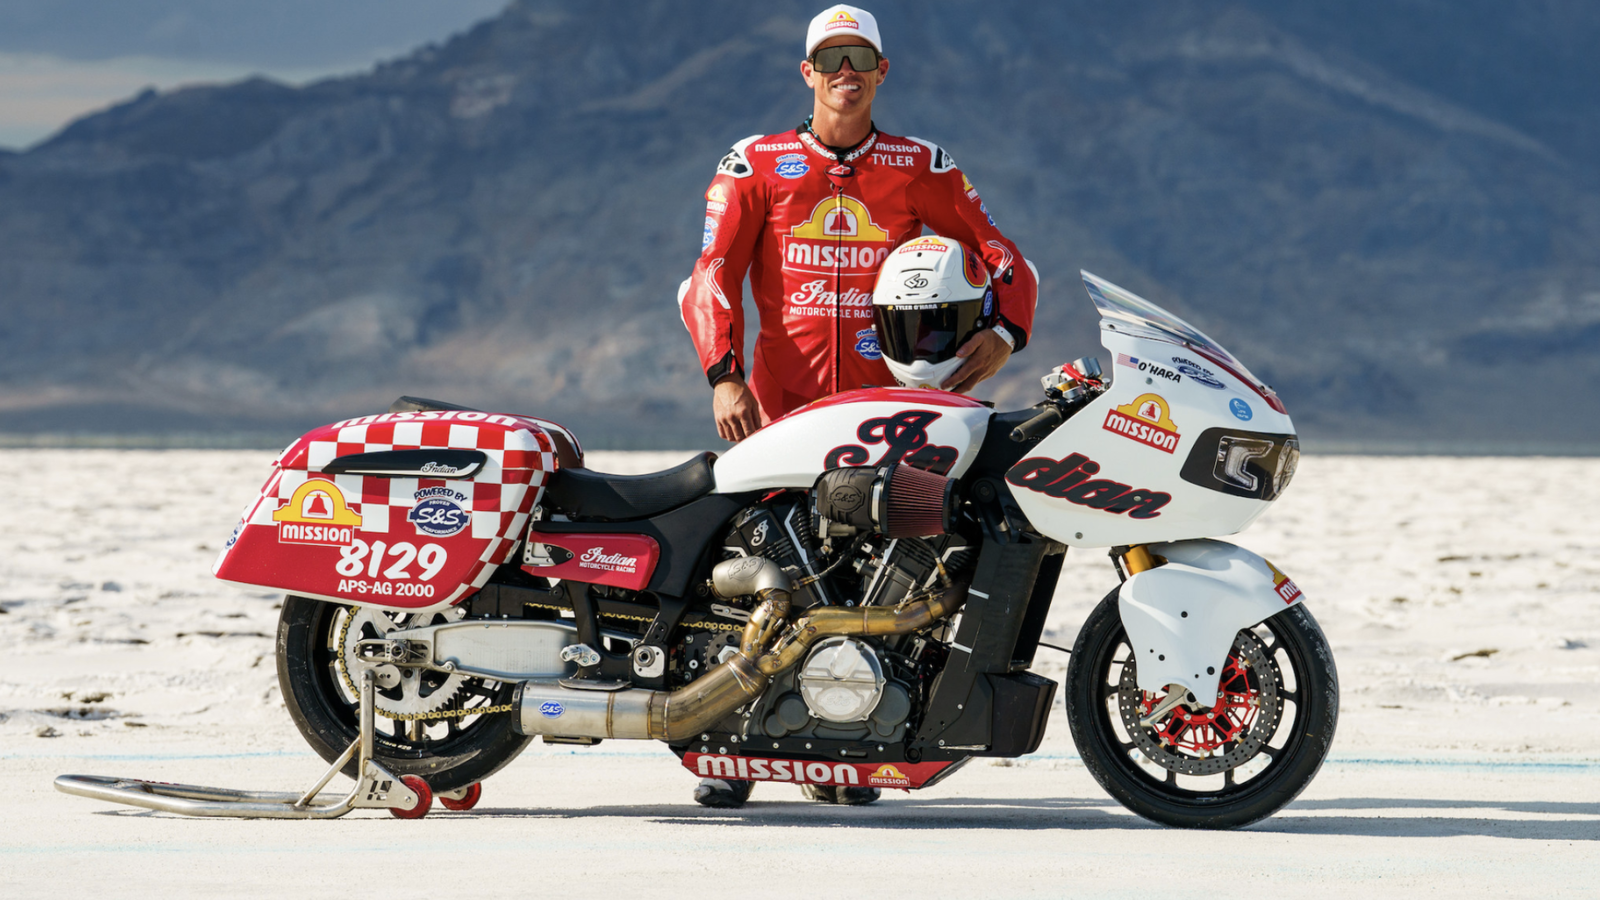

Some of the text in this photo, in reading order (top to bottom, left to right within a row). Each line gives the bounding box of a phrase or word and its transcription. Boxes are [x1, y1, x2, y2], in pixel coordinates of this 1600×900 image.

[755, 142, 803, 152] MISSION
[875, 143, 921, 153] MISSION
[871, 153, 914, 167] TYLER
[779, 164, 805, 174] S&S
[901, 243, 946, 252] MISSION
[854, 309, 873, 318] RACI
[1138, 362, 1181, 383] O'HARA
[1106, 413, 1176, 450] MISSION
[421, 462, 457, 474] Indian
[1004, 452, 1172, 519] dian
[414, 487, 468, 502] POWERED BY
[416, 508, 461, 525] S&S
[282, 525, 351, 543] MISSION
[335, 538, 447, 581] 8129
[580, 547, 637, 566] Indian
[579, 562, 636, 573] MOTORCYCLE RACING
[337, 579, 434, 597] APS-AG 2000
[541, 705, 562, 713] S&S
[697, 755, 859, 784] MISSION
[870, 777, 909, 785] MISSION
